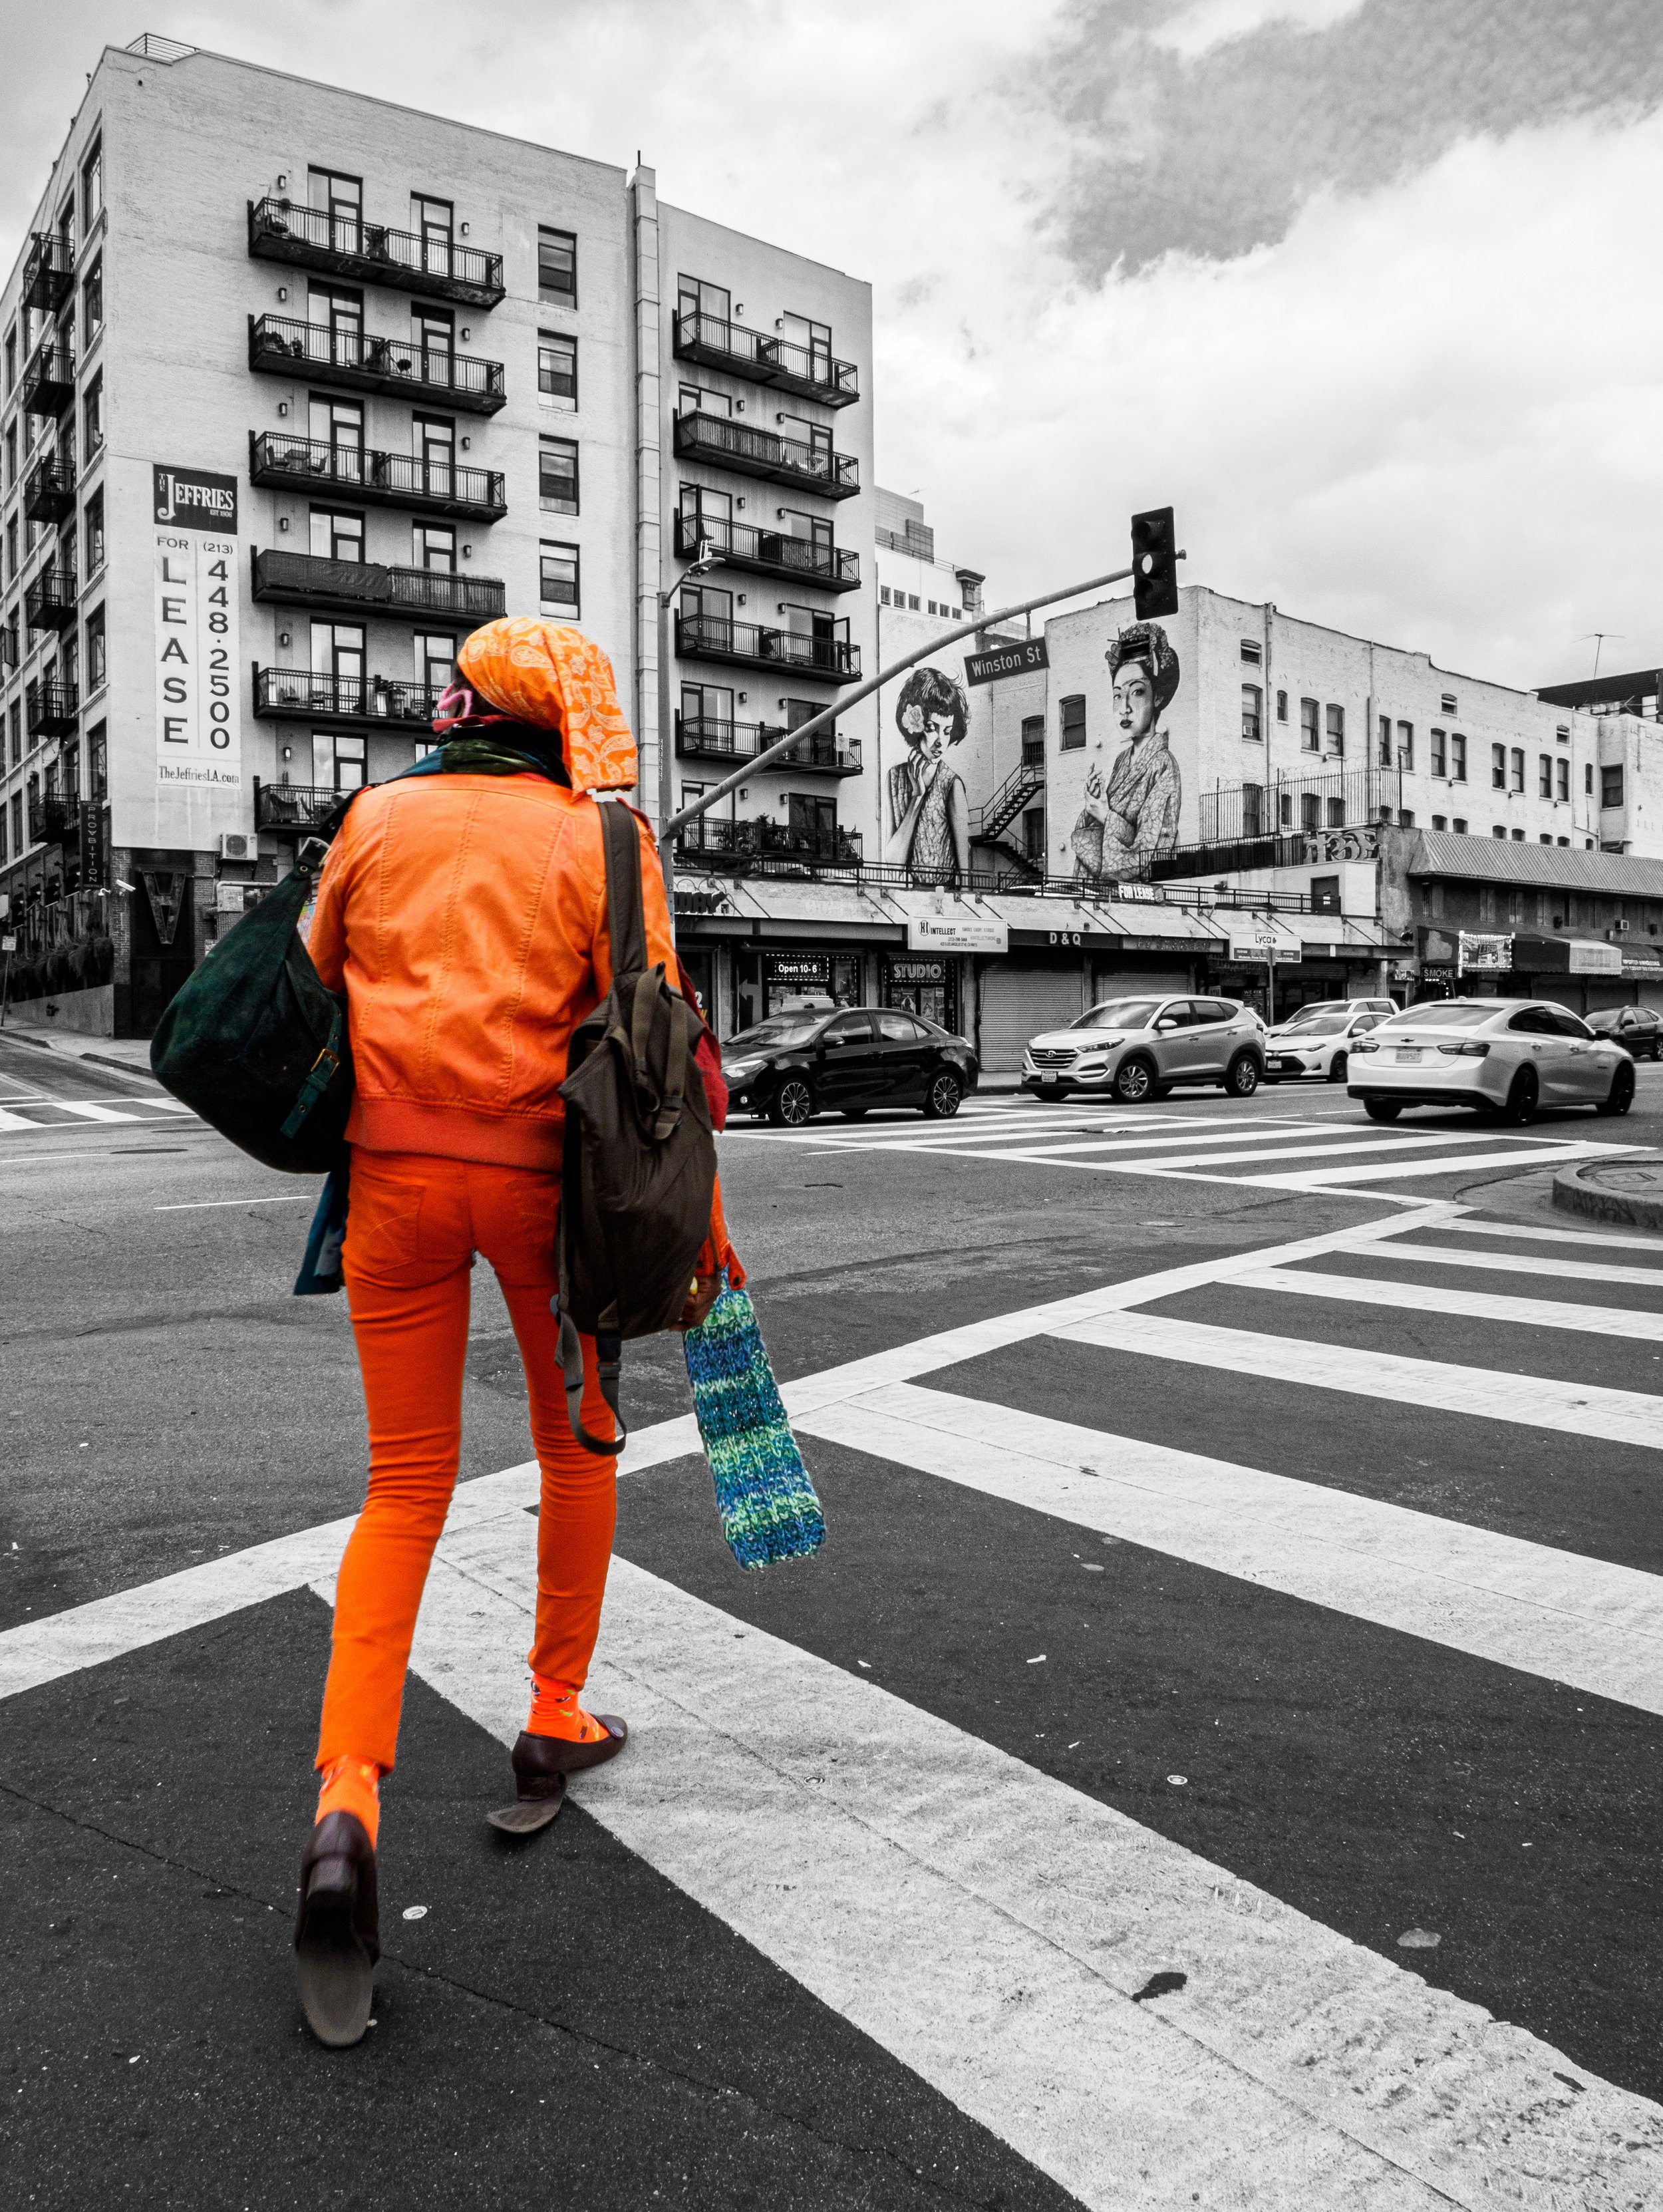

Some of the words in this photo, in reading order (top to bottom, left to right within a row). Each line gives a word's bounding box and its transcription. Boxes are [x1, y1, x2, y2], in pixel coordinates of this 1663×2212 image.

[157, 474, 234, 520] JEFFRIES
[158, 537, 189, 550] FOR
[204, 542, 233, 555] (213)
[160, 556, 190, 744] LEASE
[971, 654, 1021, 677] Winston
[1026, 646, 1042, 663] St
[158, 766, 239, 784] TheJeffriesLA.com
[1133, 886, 1155, 901] LEASE
[1050, 932, 1058, 944] D
[1062, 932, 1070, 945] &
[1072, 933, 1081, 946] Q
[1255, 933, 1272, 945] Lyca
[778, 964, 798, 975] Open
[893, 963, 941, 979] STUDIO
[1424, 968, 1453, 978] SMOKE
